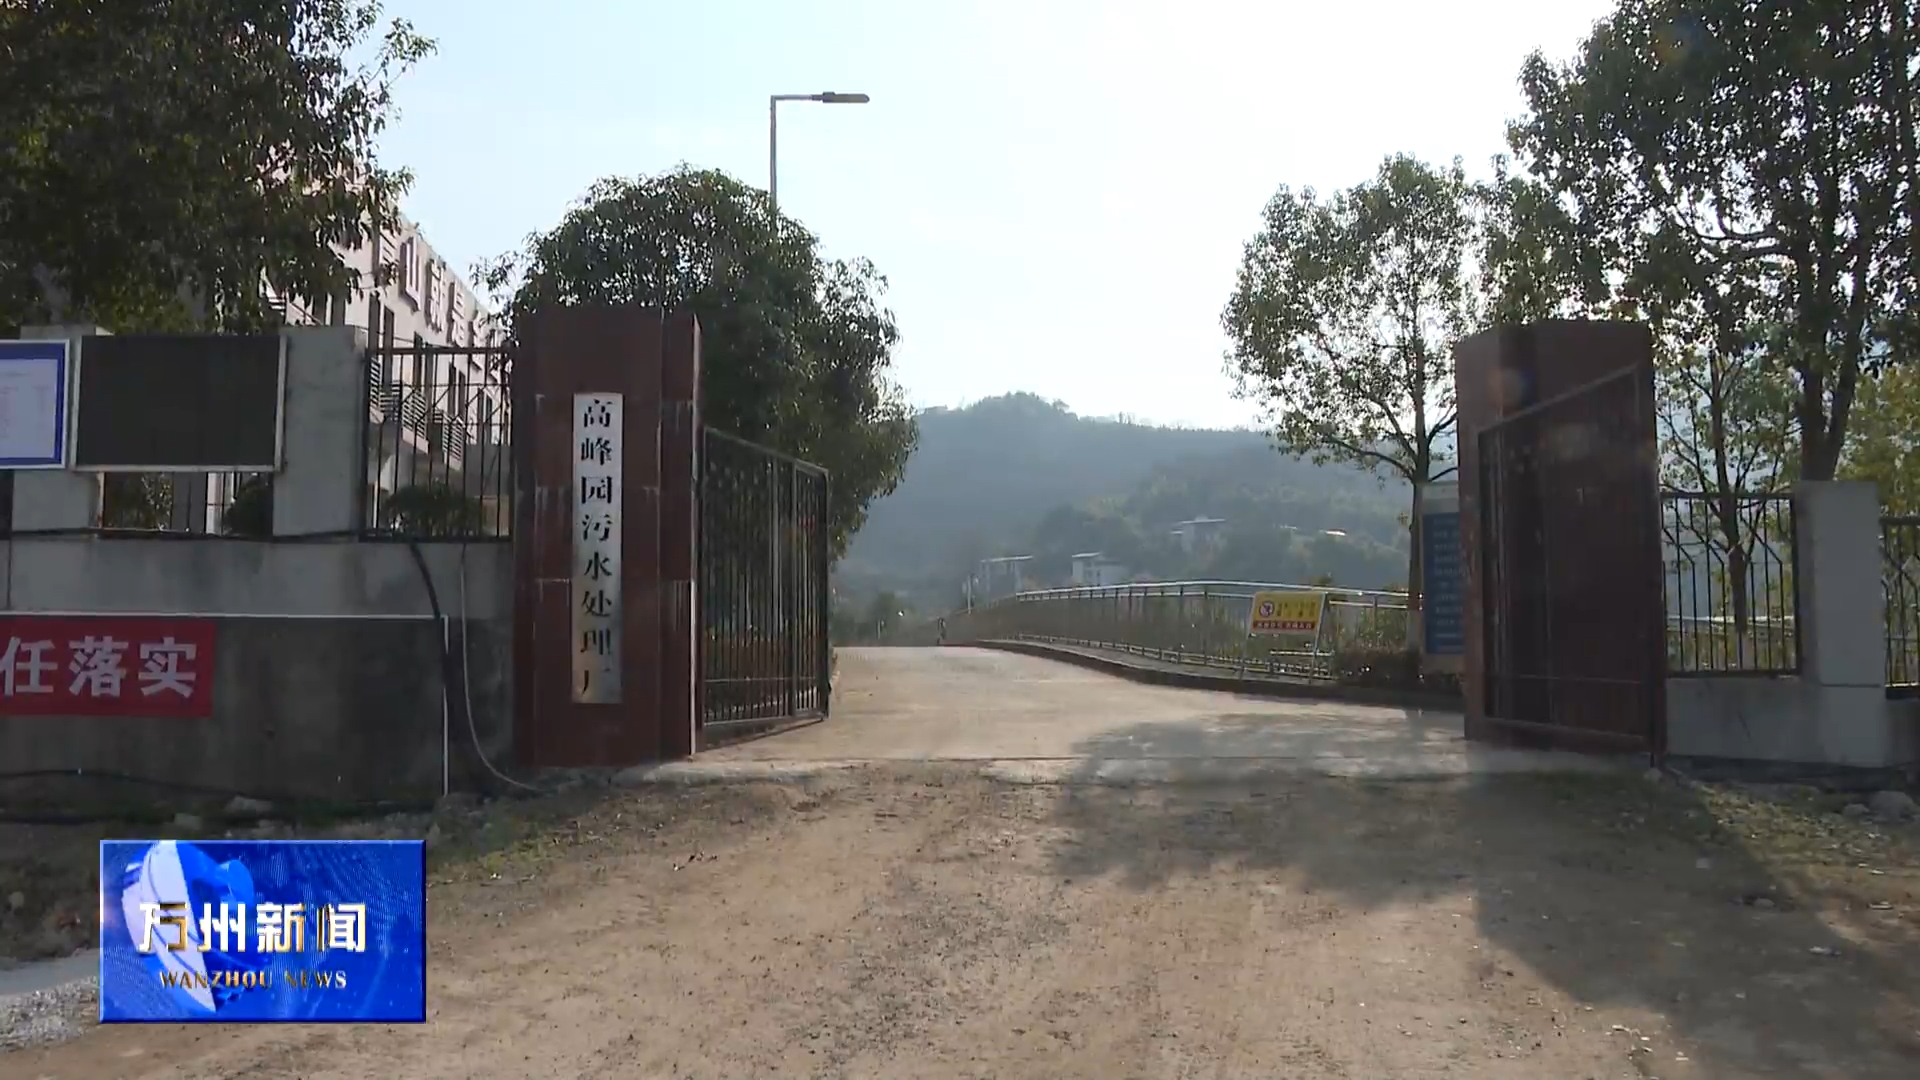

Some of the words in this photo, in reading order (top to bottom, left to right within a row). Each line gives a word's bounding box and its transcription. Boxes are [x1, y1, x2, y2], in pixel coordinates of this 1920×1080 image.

[580, 398, 614, 696] 高峰园污水处理厂
[0, 635, 198, 699] 任落实
